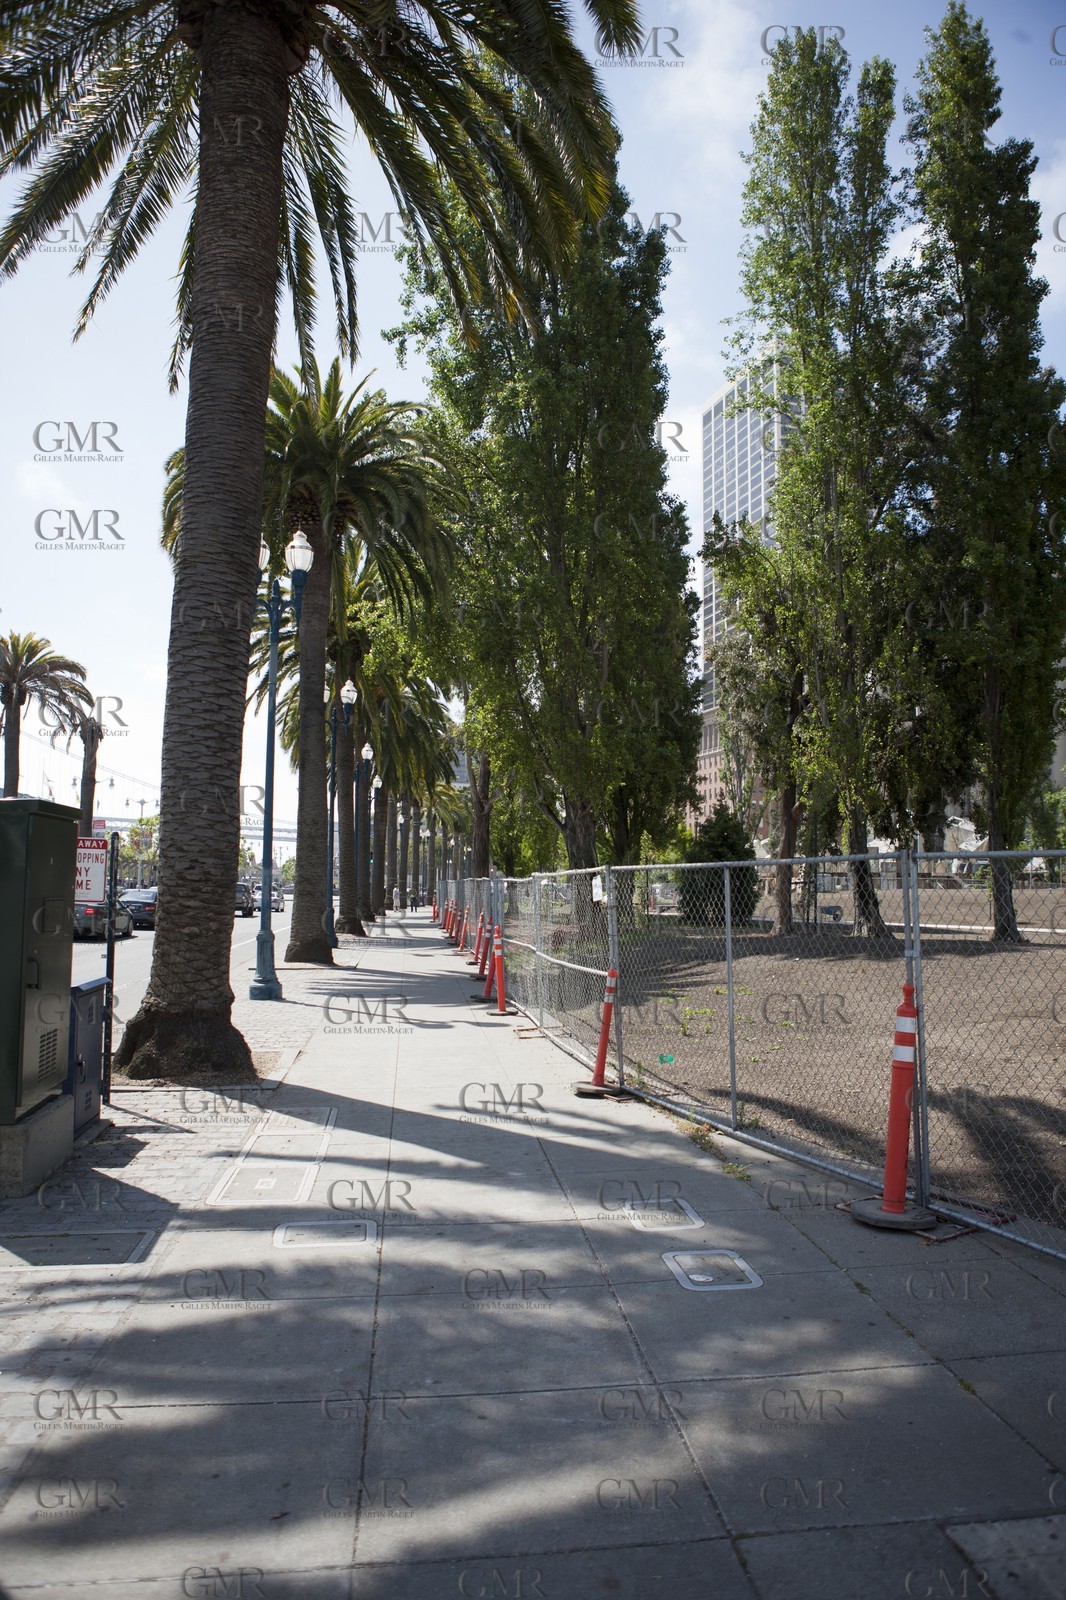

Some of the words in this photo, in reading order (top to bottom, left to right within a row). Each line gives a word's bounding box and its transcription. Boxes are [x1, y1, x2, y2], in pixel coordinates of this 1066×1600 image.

[77, 853, 104, 863] OPPING
[75, 867, 90, 877] NY
[75, 879, 91, 890] ME
